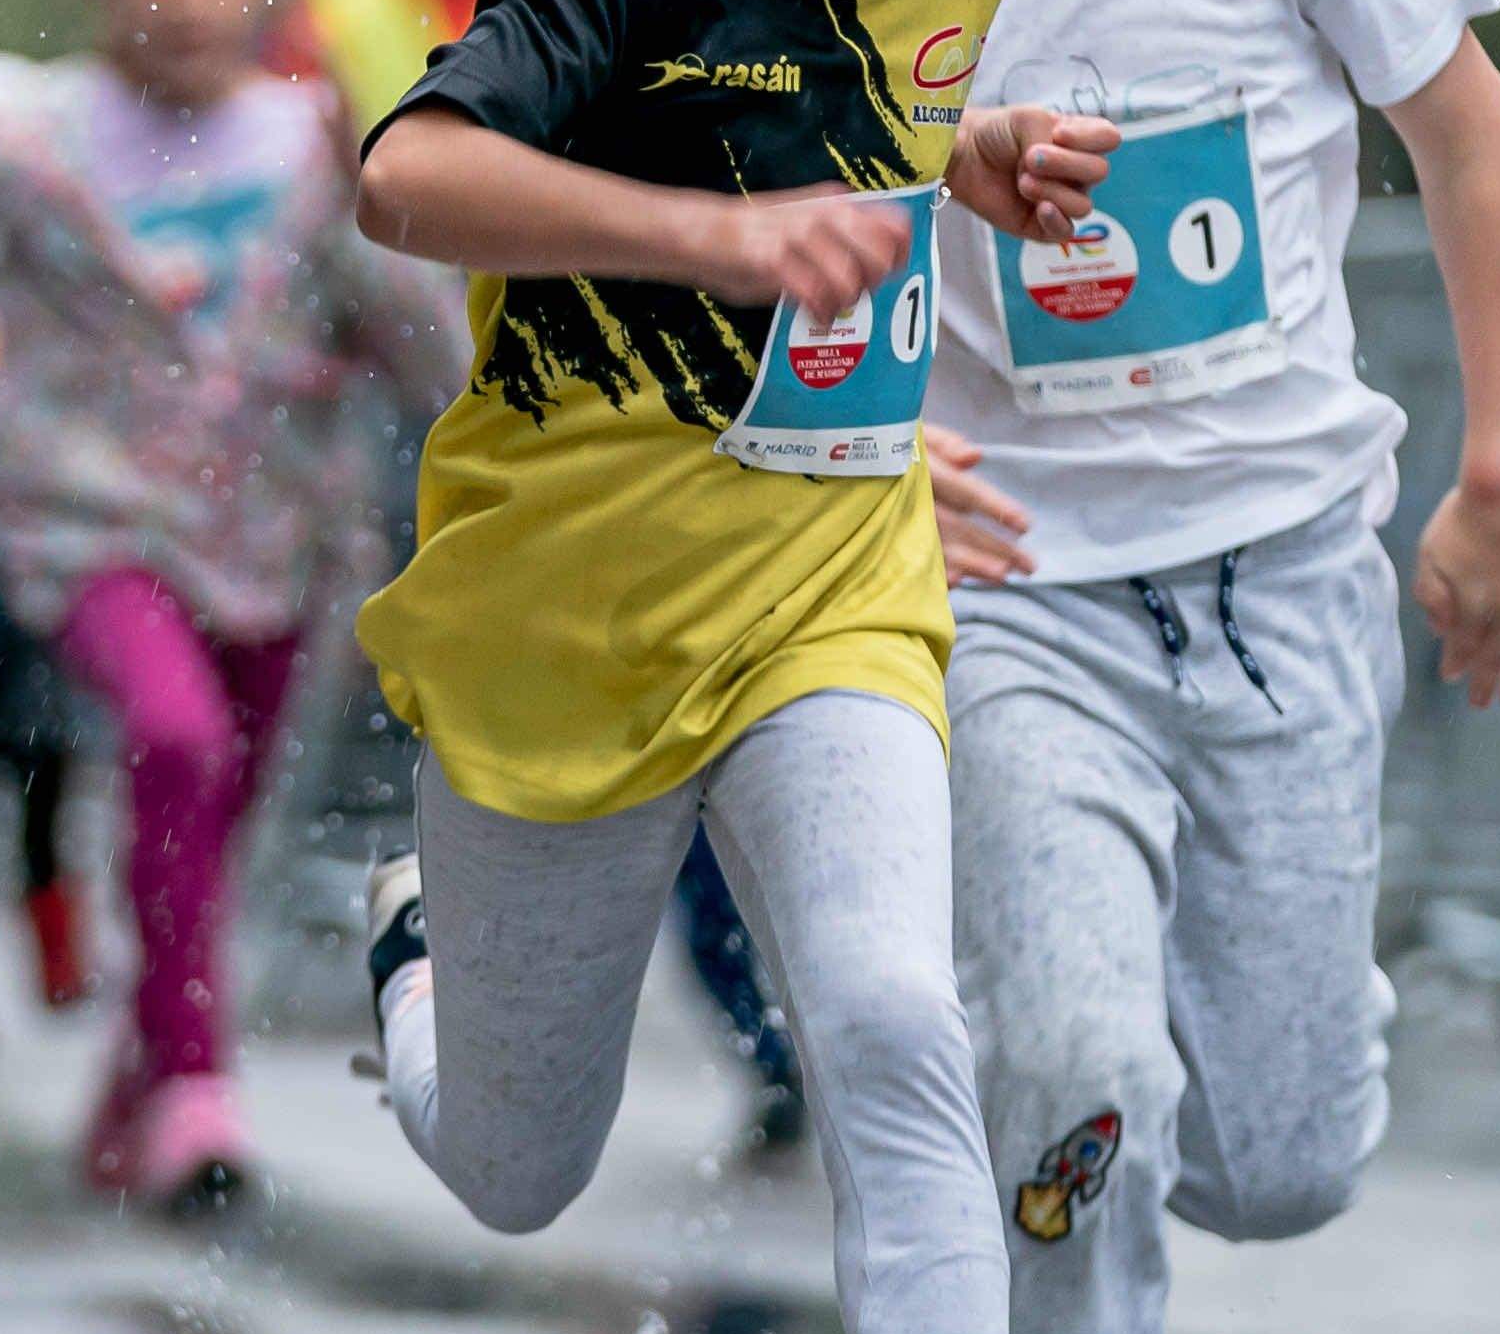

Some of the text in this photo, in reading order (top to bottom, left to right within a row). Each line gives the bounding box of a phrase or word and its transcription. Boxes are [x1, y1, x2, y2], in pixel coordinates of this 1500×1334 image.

[710, 54, 800, 92] rasán
[1191, 211, 1215, 270] 1
[907, 286, 920, 351] 1
[763, 442, 817, 457] MADRID
